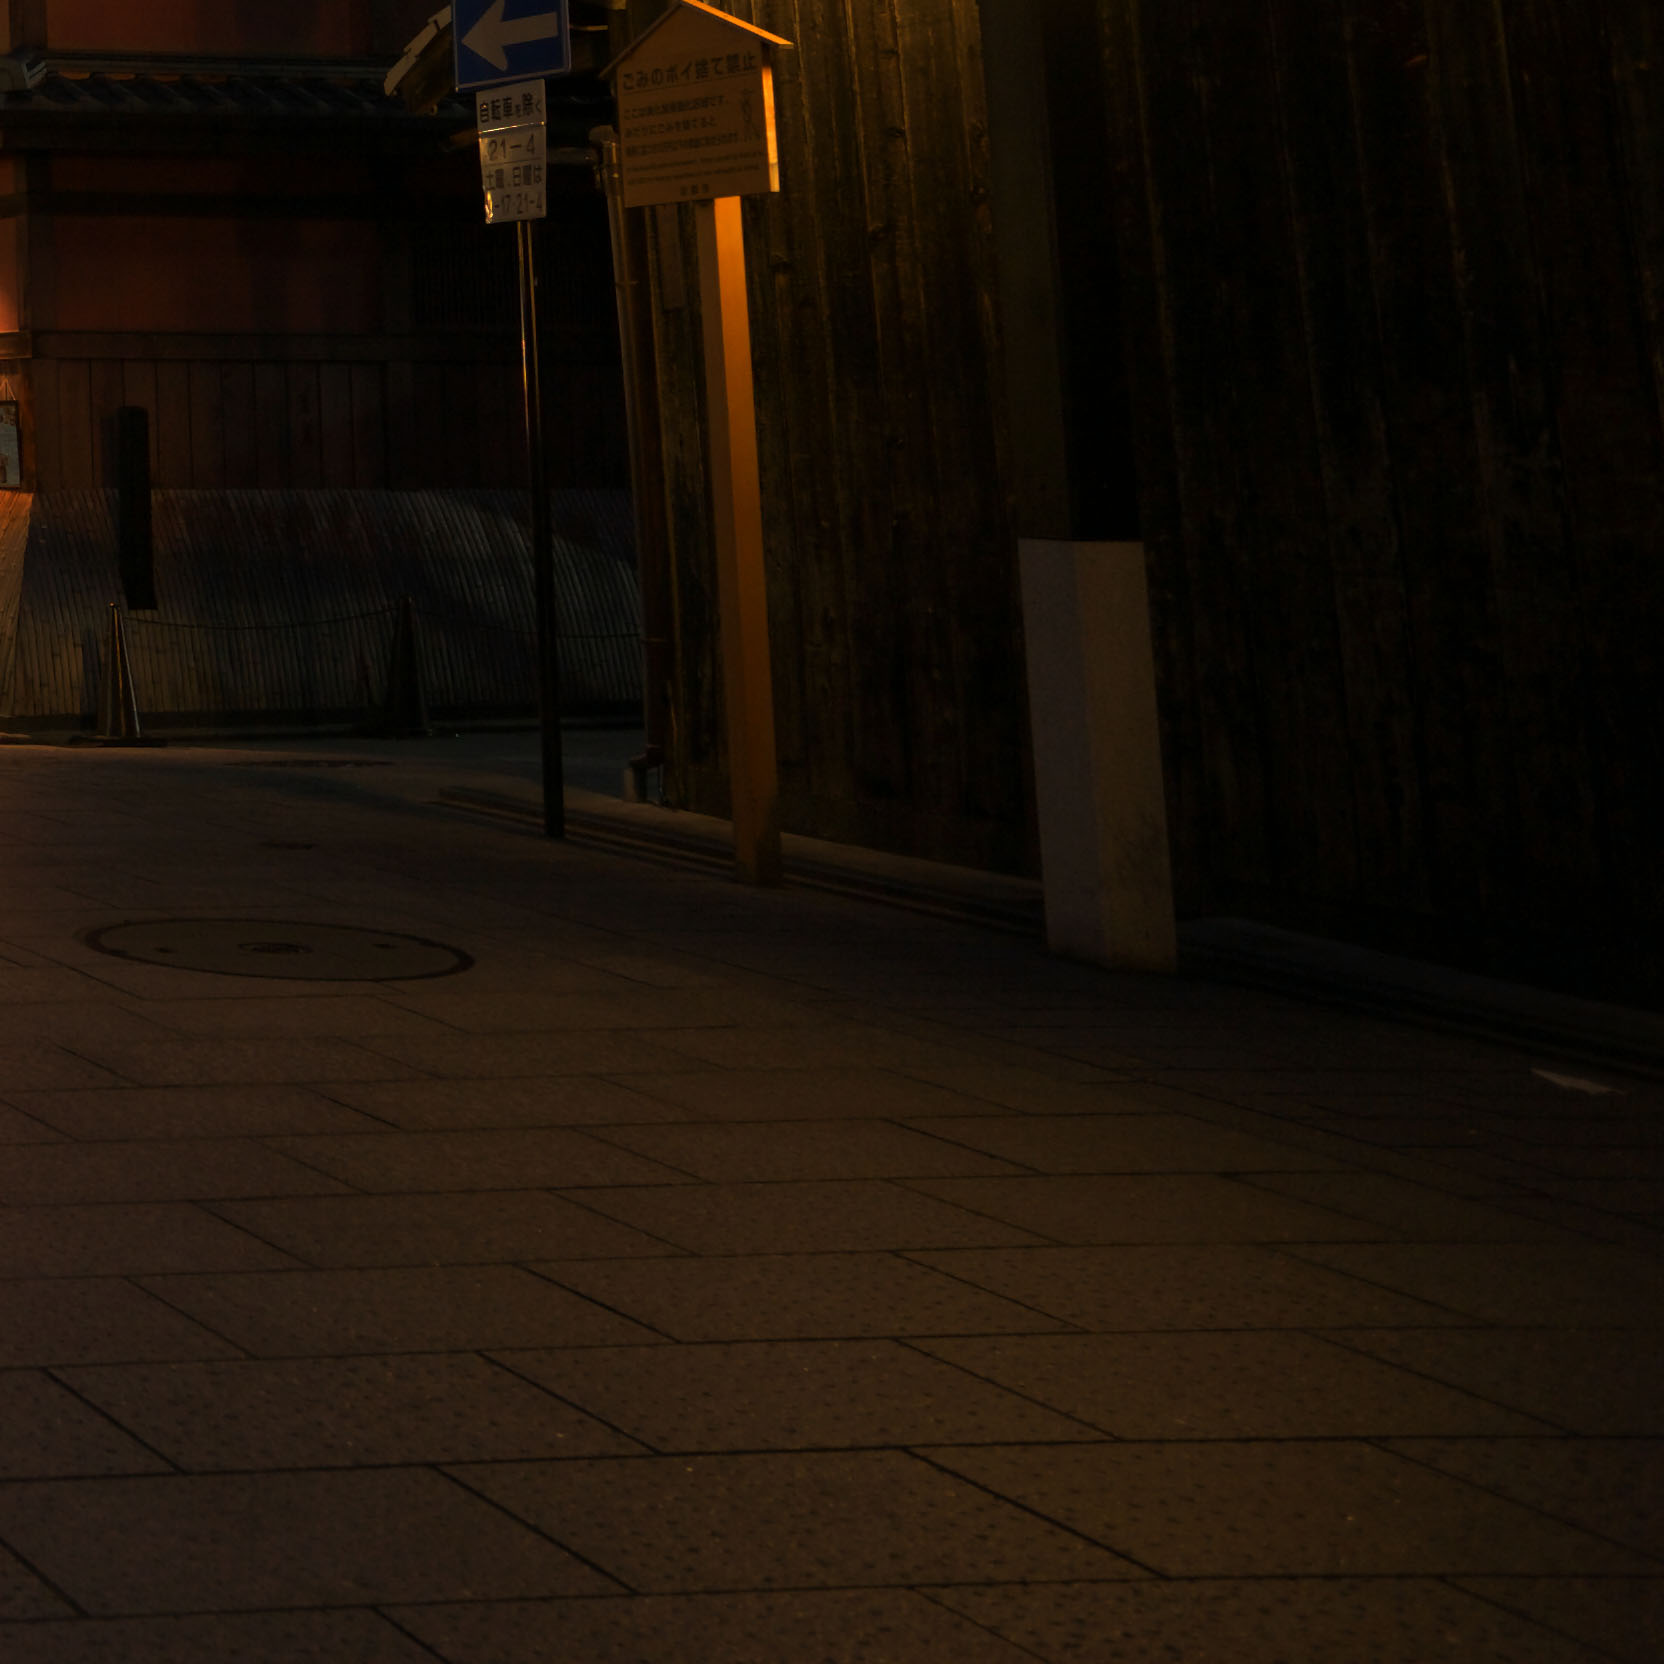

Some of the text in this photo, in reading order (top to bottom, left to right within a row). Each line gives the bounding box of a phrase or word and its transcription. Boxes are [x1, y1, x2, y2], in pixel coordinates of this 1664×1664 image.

[480, 93, 543, 124] 自転車を除く
